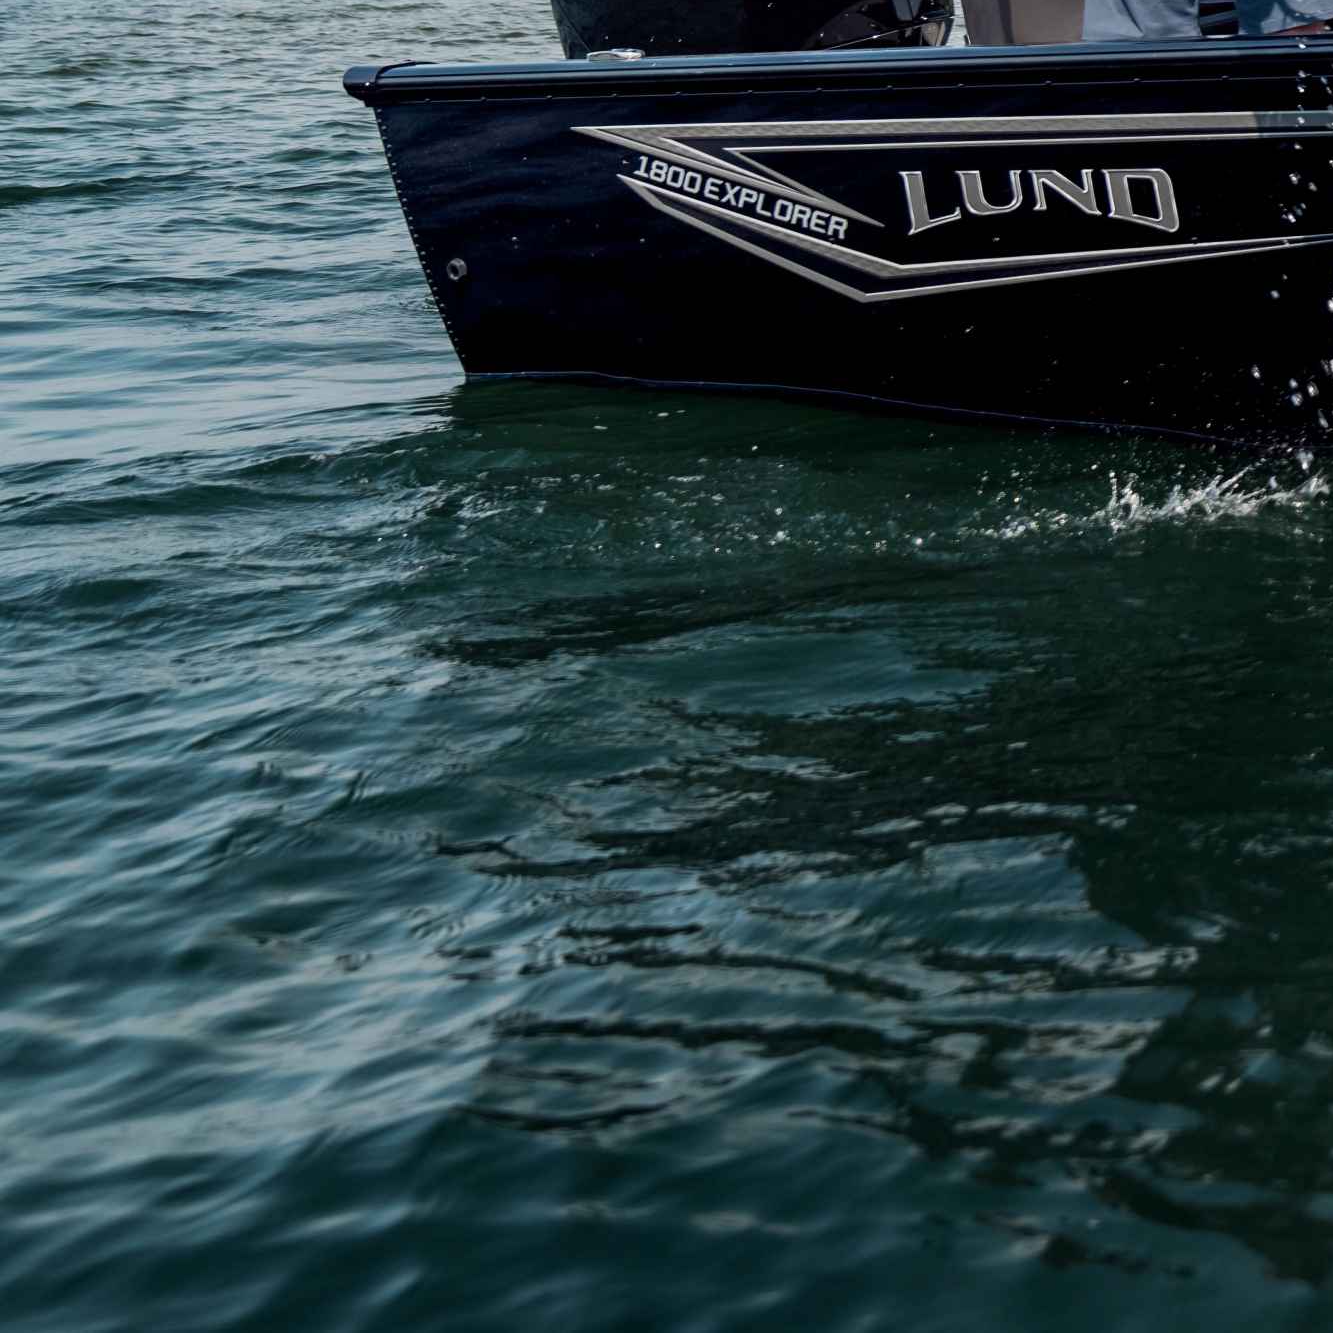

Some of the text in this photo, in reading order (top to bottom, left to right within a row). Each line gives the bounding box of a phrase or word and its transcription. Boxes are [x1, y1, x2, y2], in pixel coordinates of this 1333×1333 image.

[634, 155, 849, 240] 1800 EXPLORER
[898, 168, 1180, 234] LUND
